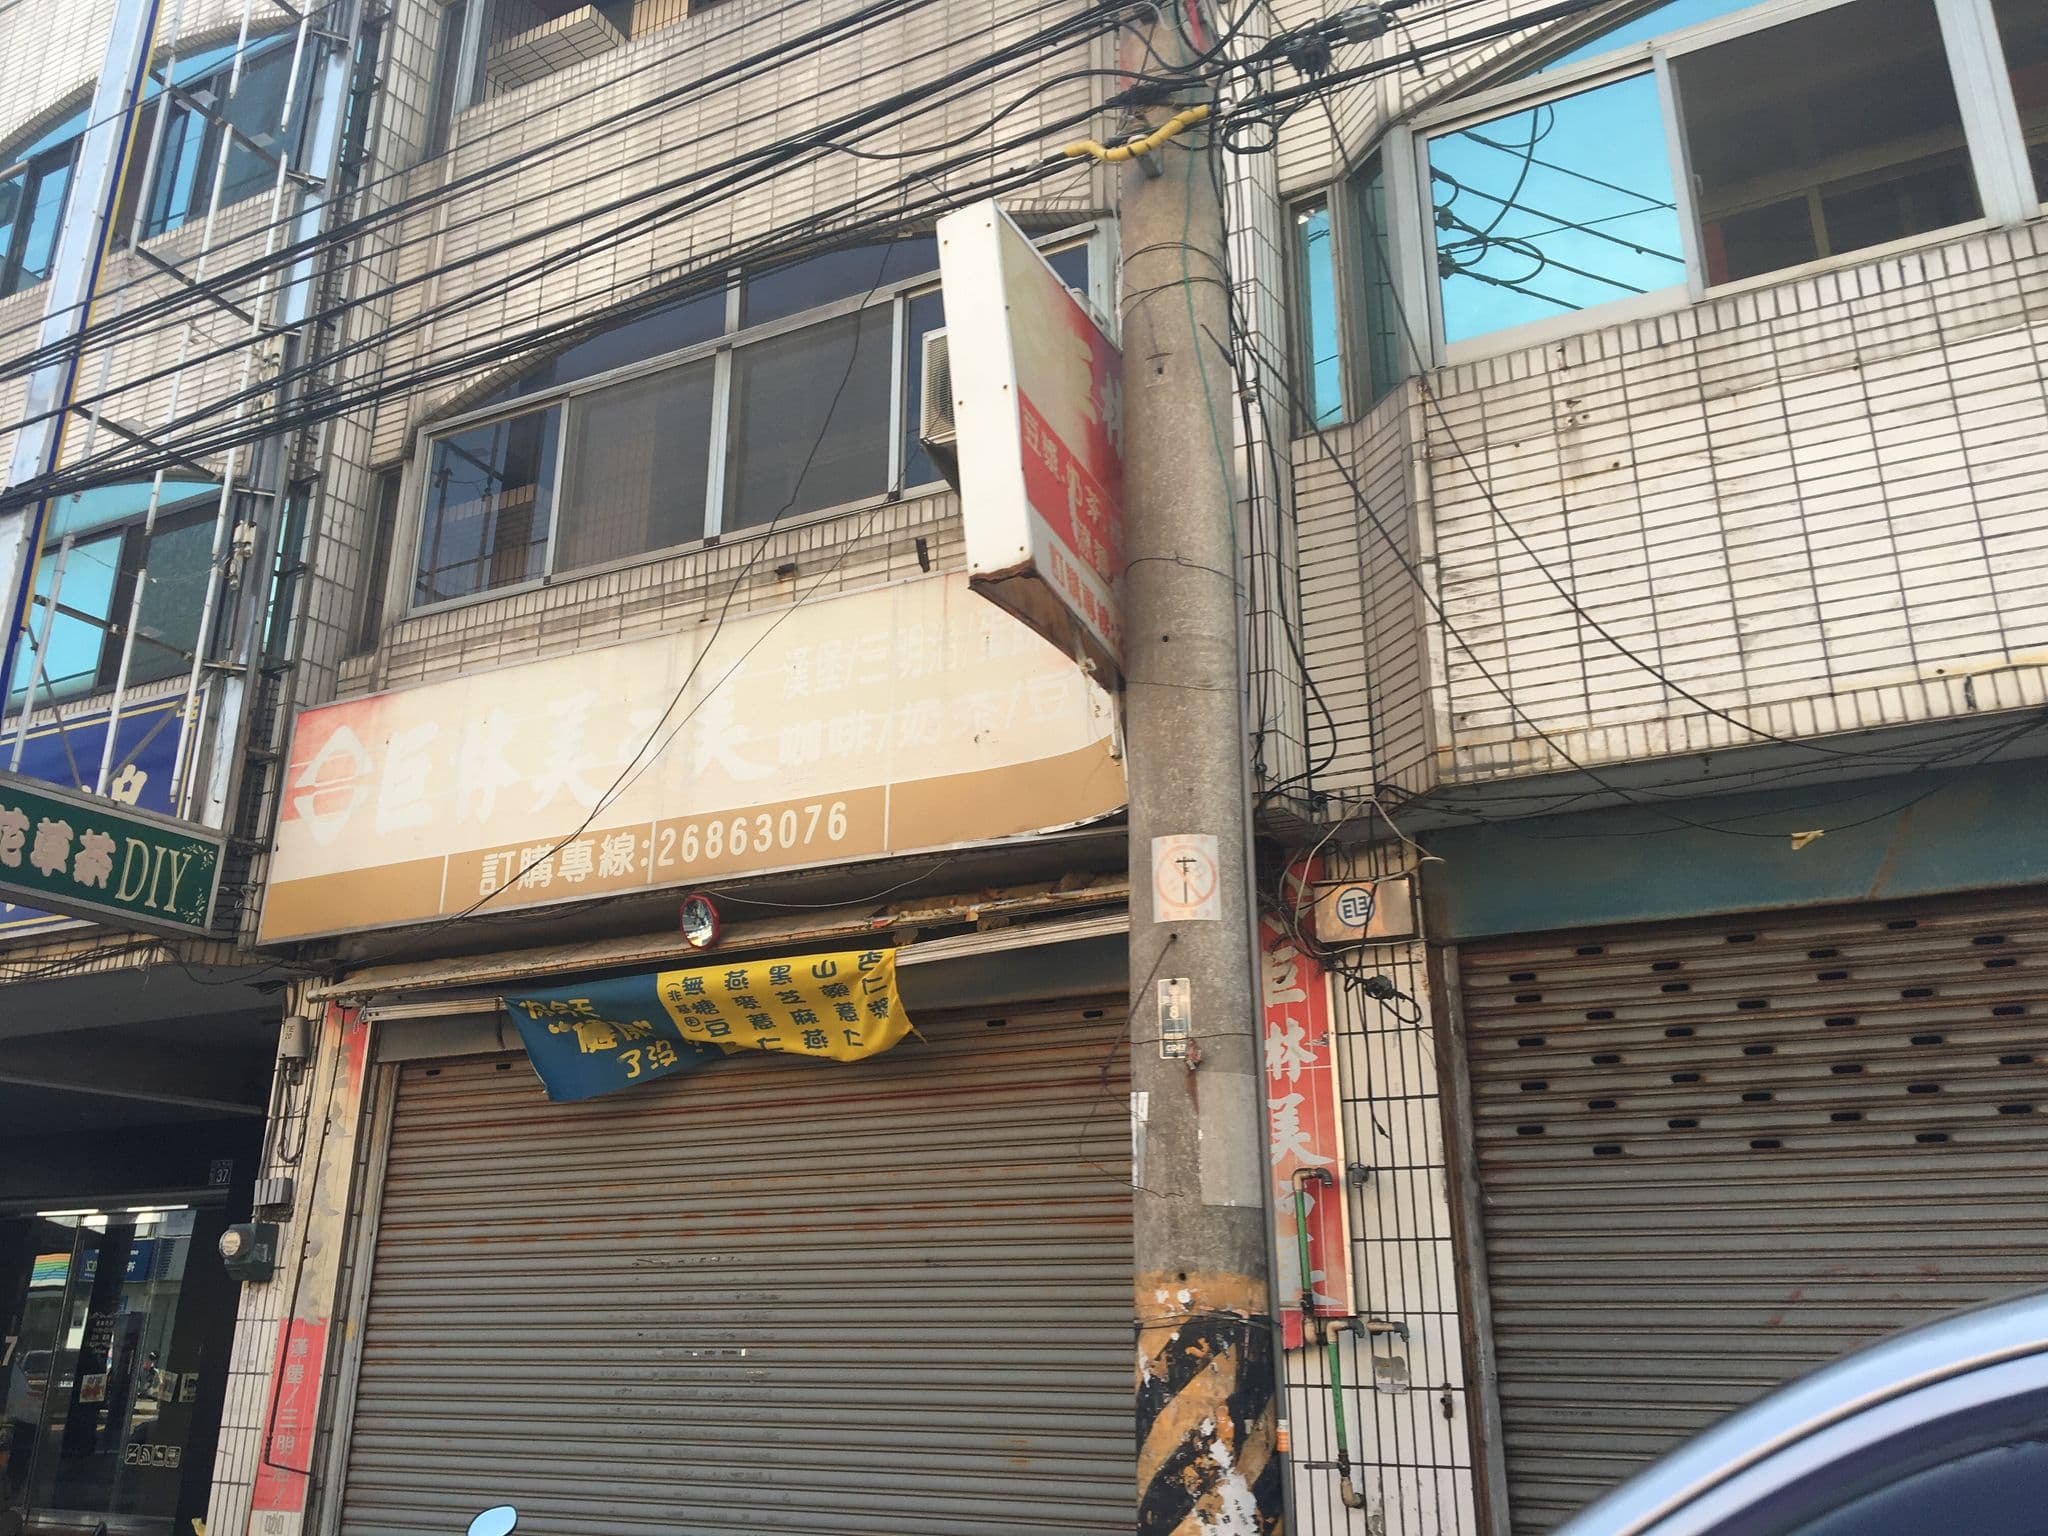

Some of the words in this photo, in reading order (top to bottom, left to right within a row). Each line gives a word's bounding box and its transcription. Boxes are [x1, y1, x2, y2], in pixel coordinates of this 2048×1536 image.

[681, 975, 733, 1044] 無糖豆
[215, 1168, 230, 1183] 37
